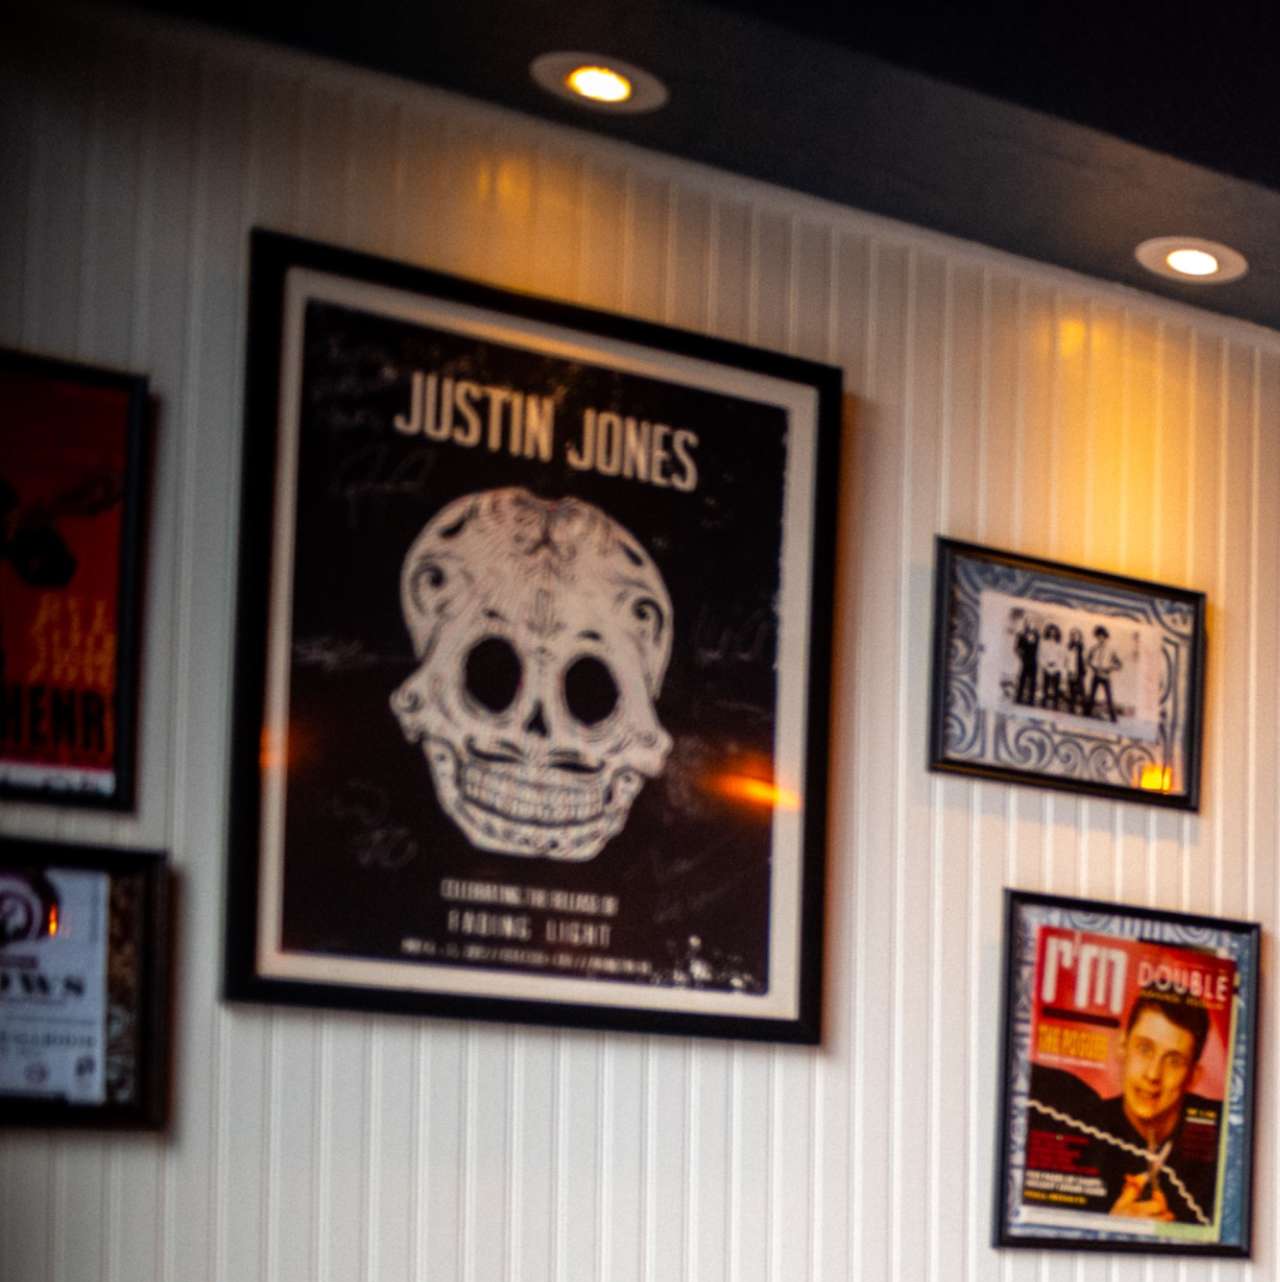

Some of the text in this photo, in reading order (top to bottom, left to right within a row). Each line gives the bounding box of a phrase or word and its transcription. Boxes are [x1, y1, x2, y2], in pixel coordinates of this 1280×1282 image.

[392, 371, 700, 493] JUSTIN JONES
[1137, 961, 1229, 1002] DOUBLE
